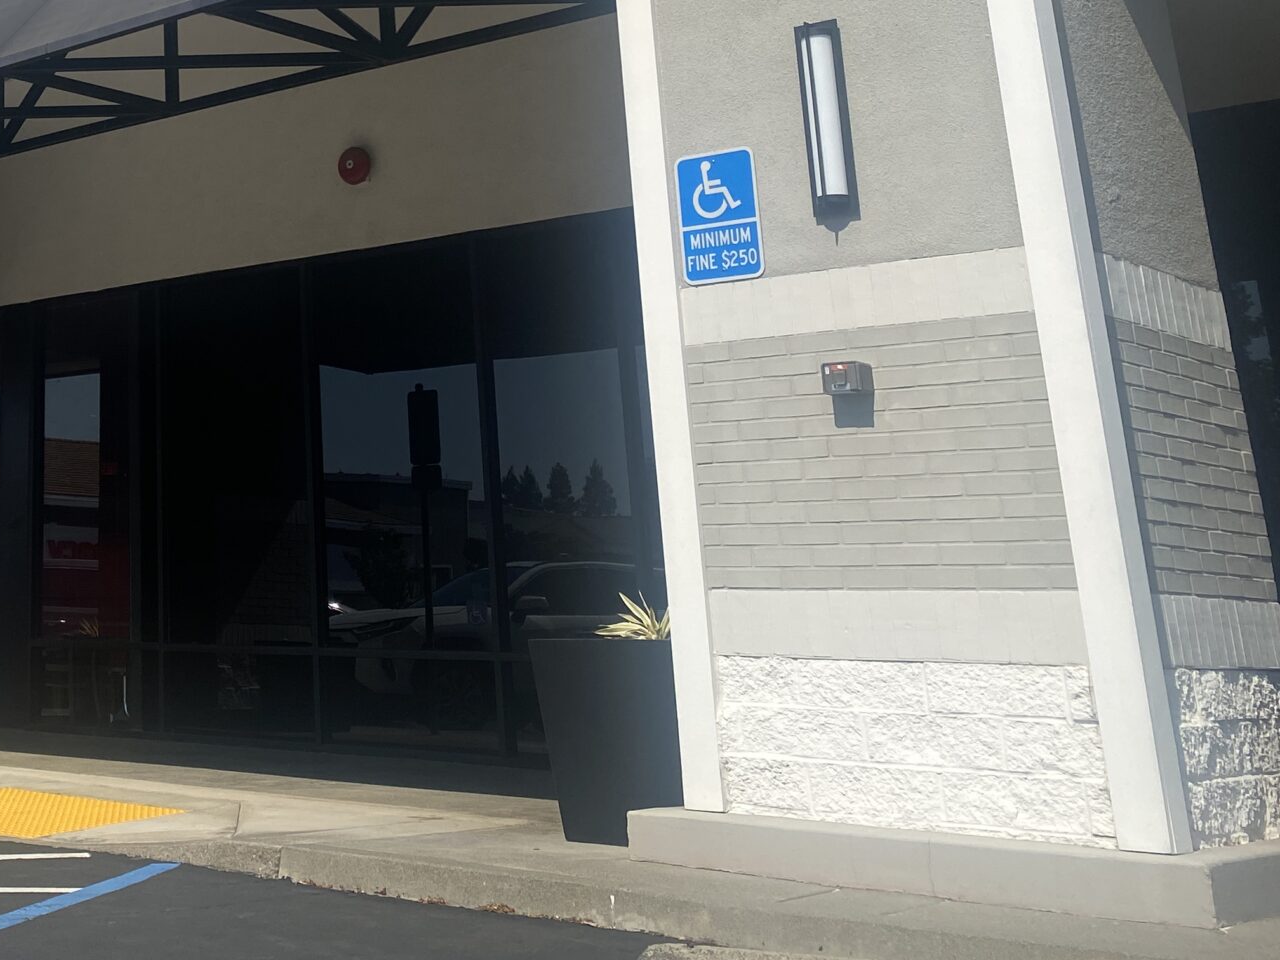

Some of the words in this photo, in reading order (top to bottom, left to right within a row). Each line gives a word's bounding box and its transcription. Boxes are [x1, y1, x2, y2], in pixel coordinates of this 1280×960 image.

[690, 226, 751, 250] MINIMUM
[687, 253, 718, 272] FINE
[721, 248, 758, 271] $250
